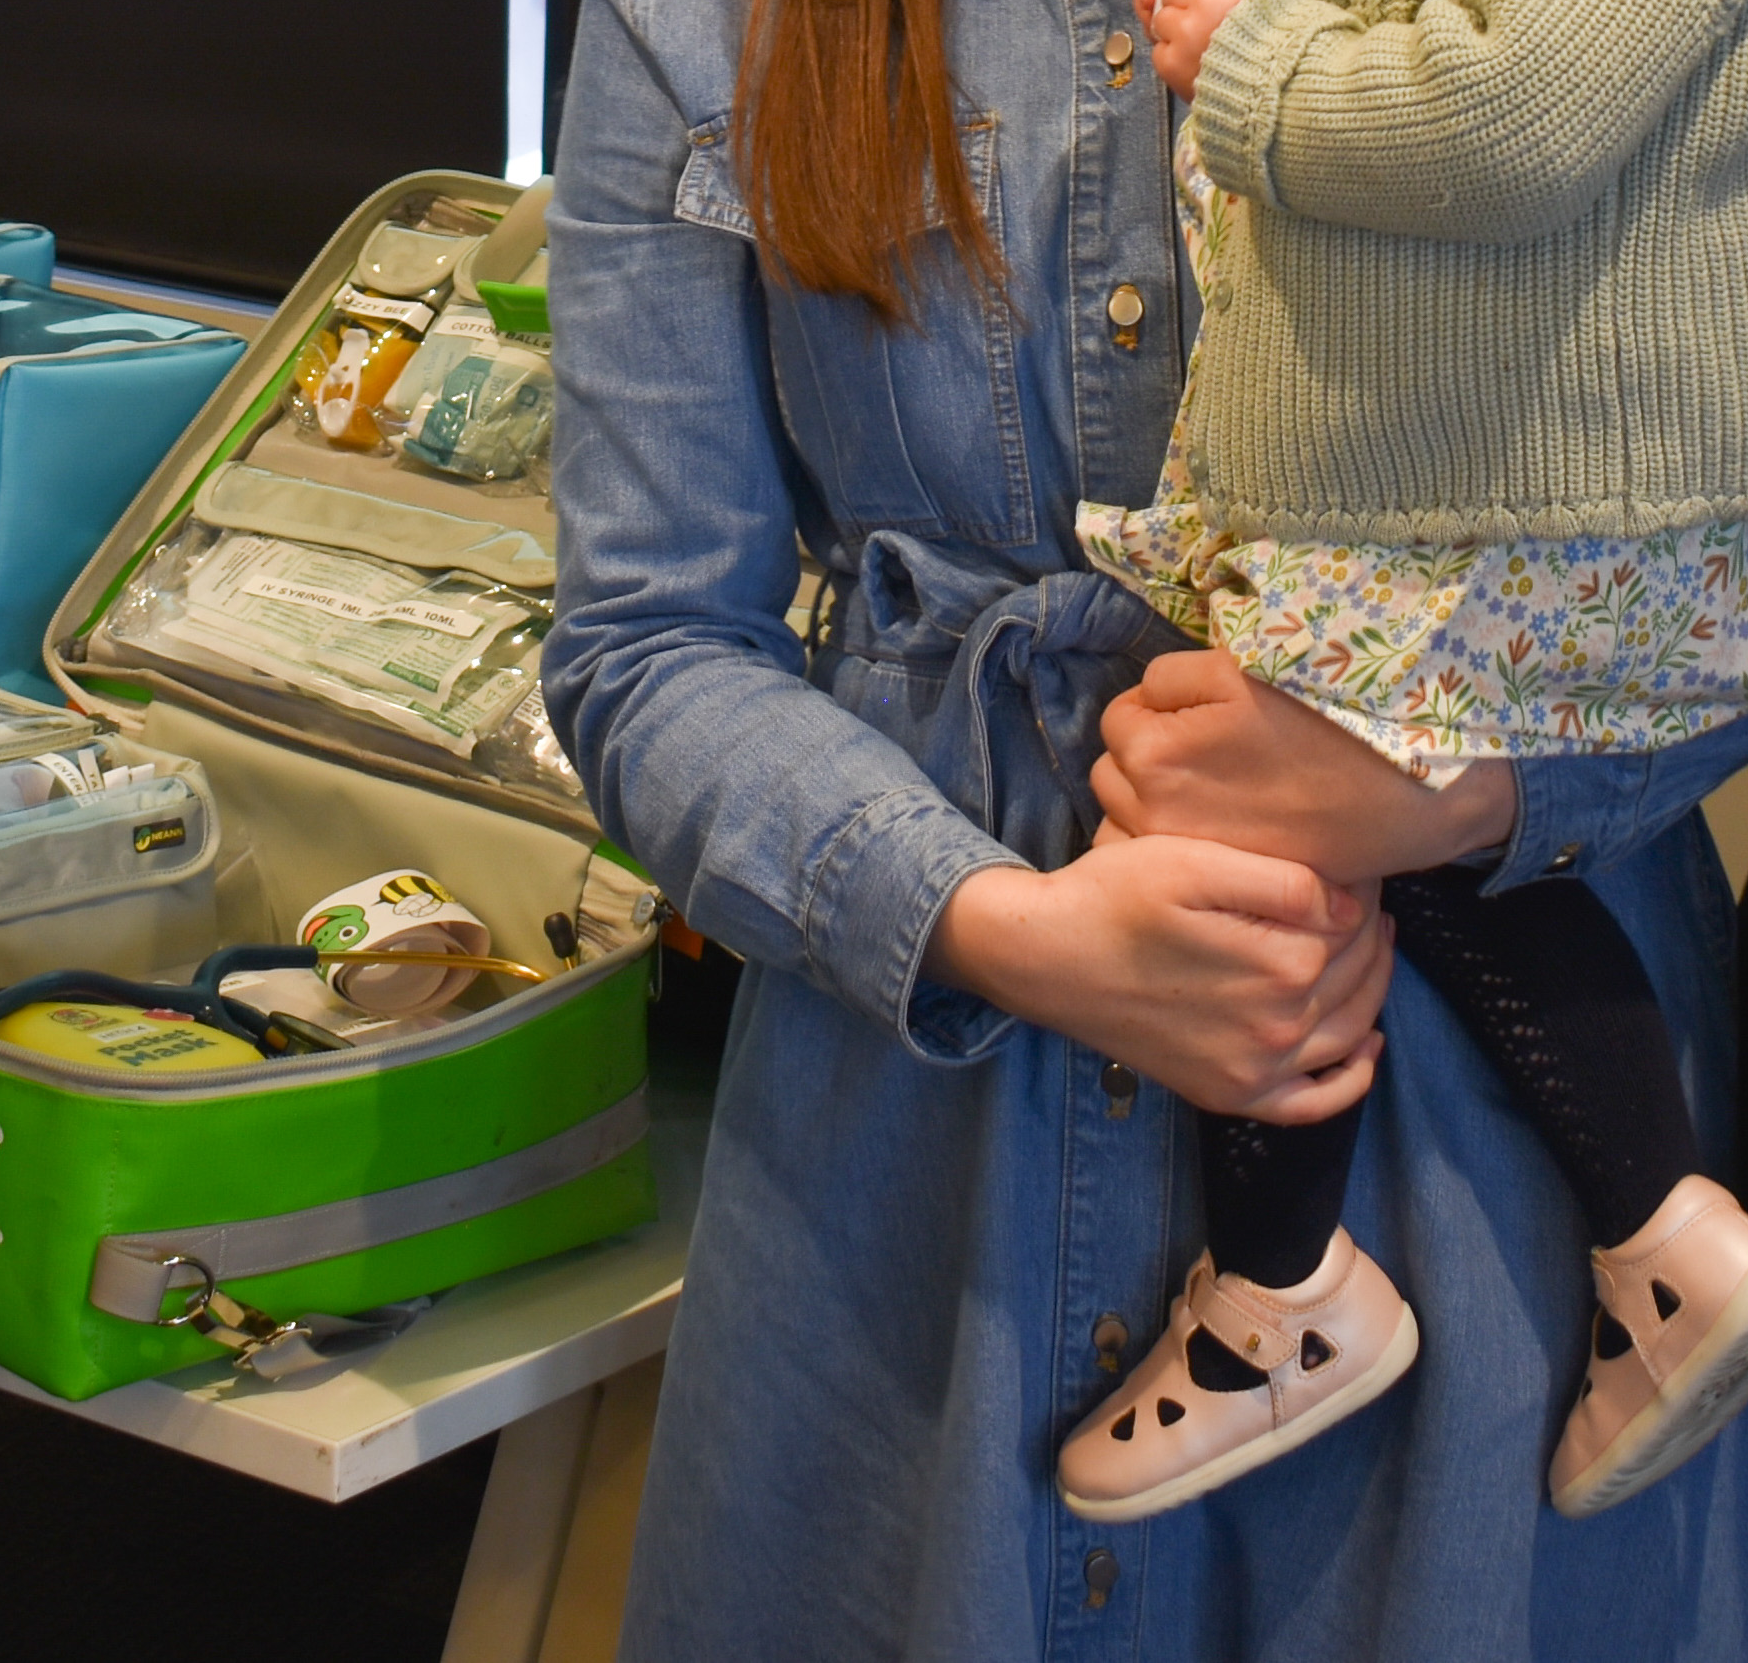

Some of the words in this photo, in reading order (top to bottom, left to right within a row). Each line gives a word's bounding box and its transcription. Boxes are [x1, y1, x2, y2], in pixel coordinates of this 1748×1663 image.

[260, 583, 275, 592] IV
[278, 587, 337, 607] SYRINGE
[424, 610, 456, 628] 10ML
[97, 1029, 195, 1056] Pocket
[117, 1037, 220, 1067] Mask
